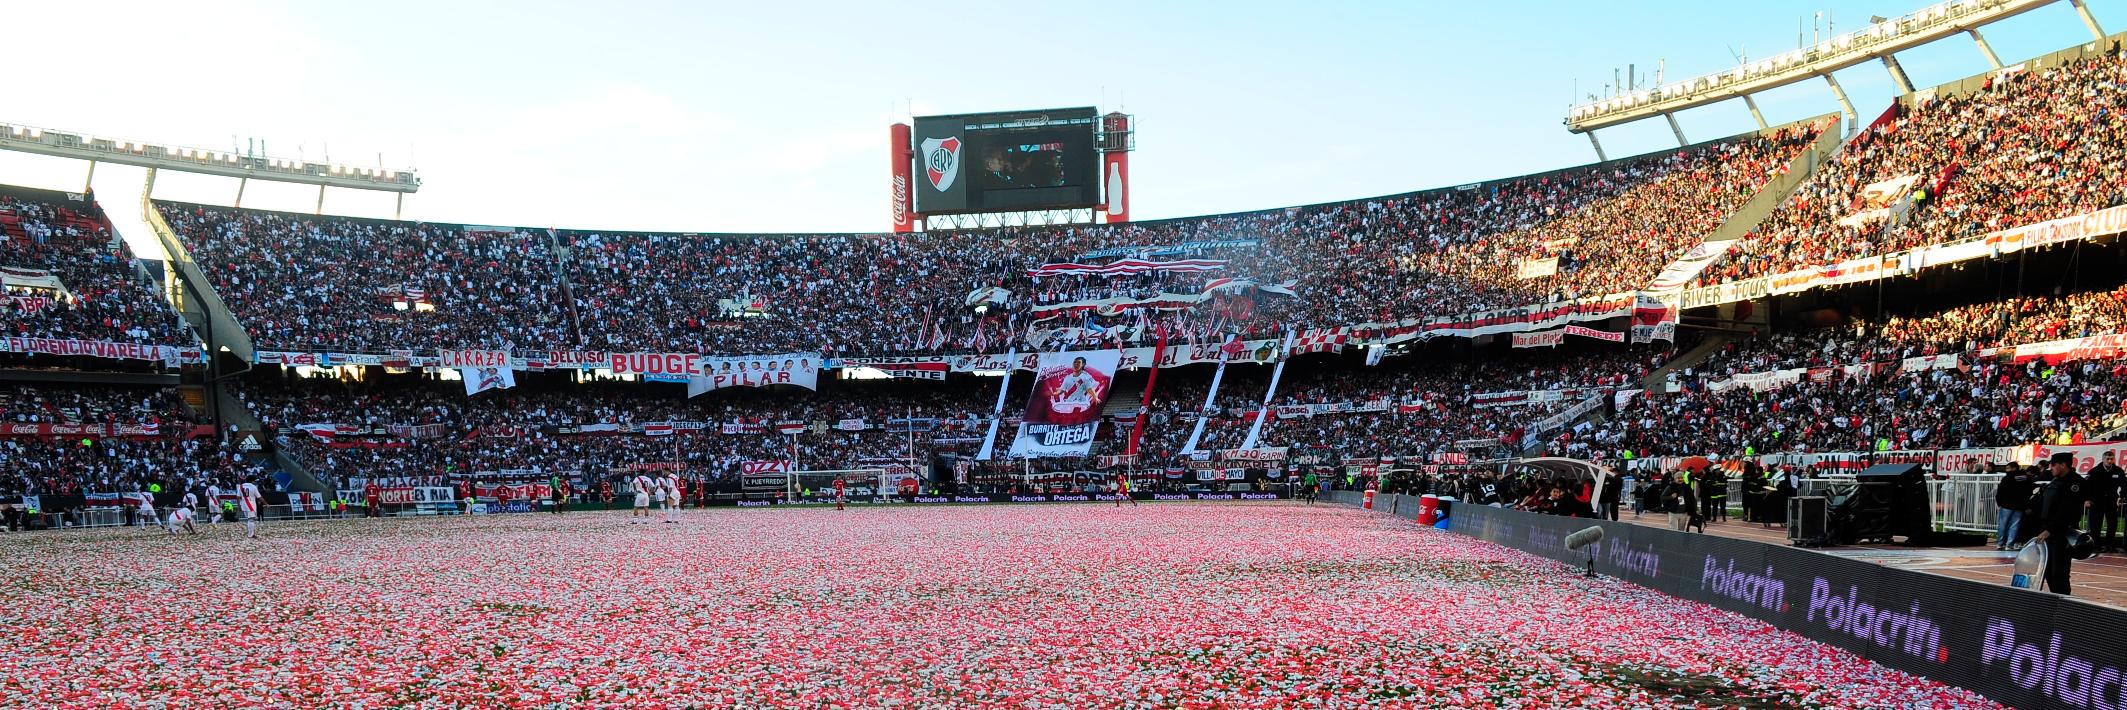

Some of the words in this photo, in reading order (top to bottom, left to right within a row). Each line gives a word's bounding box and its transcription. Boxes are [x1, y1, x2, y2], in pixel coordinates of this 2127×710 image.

[1682, 287, 1723, 307] RIVER
[1730, 280, 1768, 300] TOUR
[1567, 298, 1628, 318] PAREDES
[1513, 333, 1527, 346] Mar
[1528, 332, 1540, 345] del
[10, 338, 93, 355] FLORENCIO
[95, 342, 161, 360] VARELA
[442, 350, 506, 367] CARAZA
[611, 354, 700, 374] BUDGE
[714, 371, 791, 389] PILAR
[12, 424, 39, 434] Coca-Cola
[1029, 424, 1059, 435] BURRITO
[1043, 428, 1090, 446] ORTEGA
[742, 460, 792, 474] OZZY
[1776, 456, 1804, 467] VILLA
[1197, 470, 1214, 479] VILLA
[1215, 470, 1224, 479] DE
[1225, 470, 1243, 478] MAYO
[379, 489, 414, 502] NORTE
[914, 496, 948, 504] Polacrin
[1012, 495, 1046, 503] Polacrin
[1053, 494, 1088, 502] Polacrin
[1154, 493, 1189, 501] Polacrin
[1197, 493, 1233, 501] Polacrin
[1240, 492, 1277, 500] Polacrin
